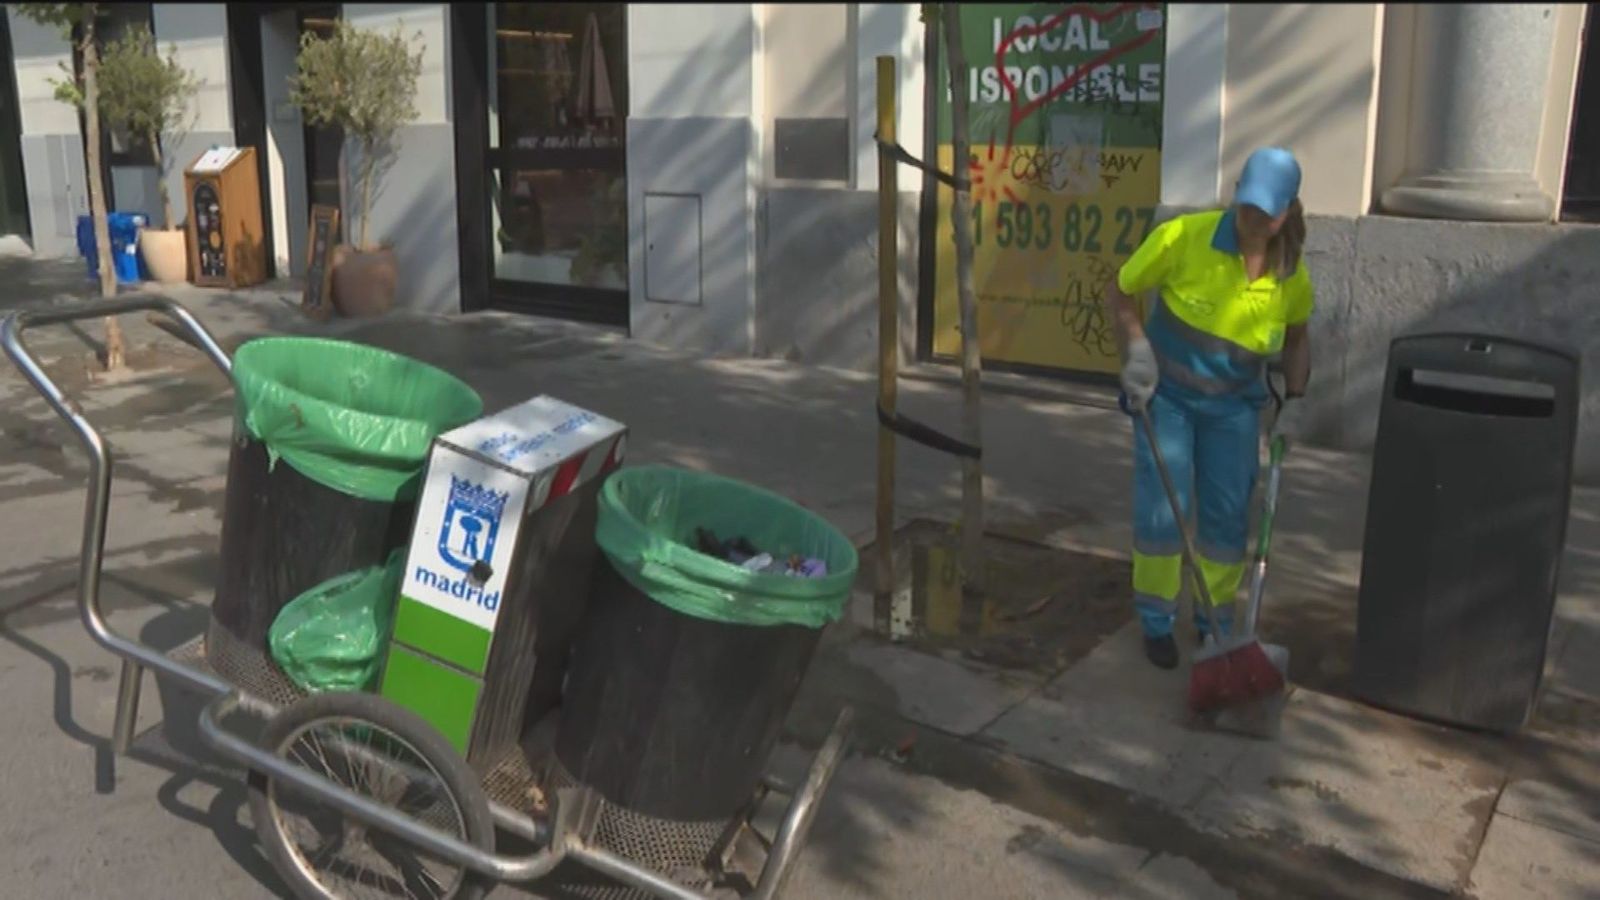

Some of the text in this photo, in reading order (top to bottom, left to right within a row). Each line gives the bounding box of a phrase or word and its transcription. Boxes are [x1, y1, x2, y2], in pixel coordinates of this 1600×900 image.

[993, 14, 1109, 53] LOCAL
[946, 63, 1161, 103] ISPONIBLE
[996, 201, 1052, 249] 593
[1063, 203, 1102, 252] 82
[1113, 206, 1156, 255] 27
[415, 566, 499, 611] madrid
